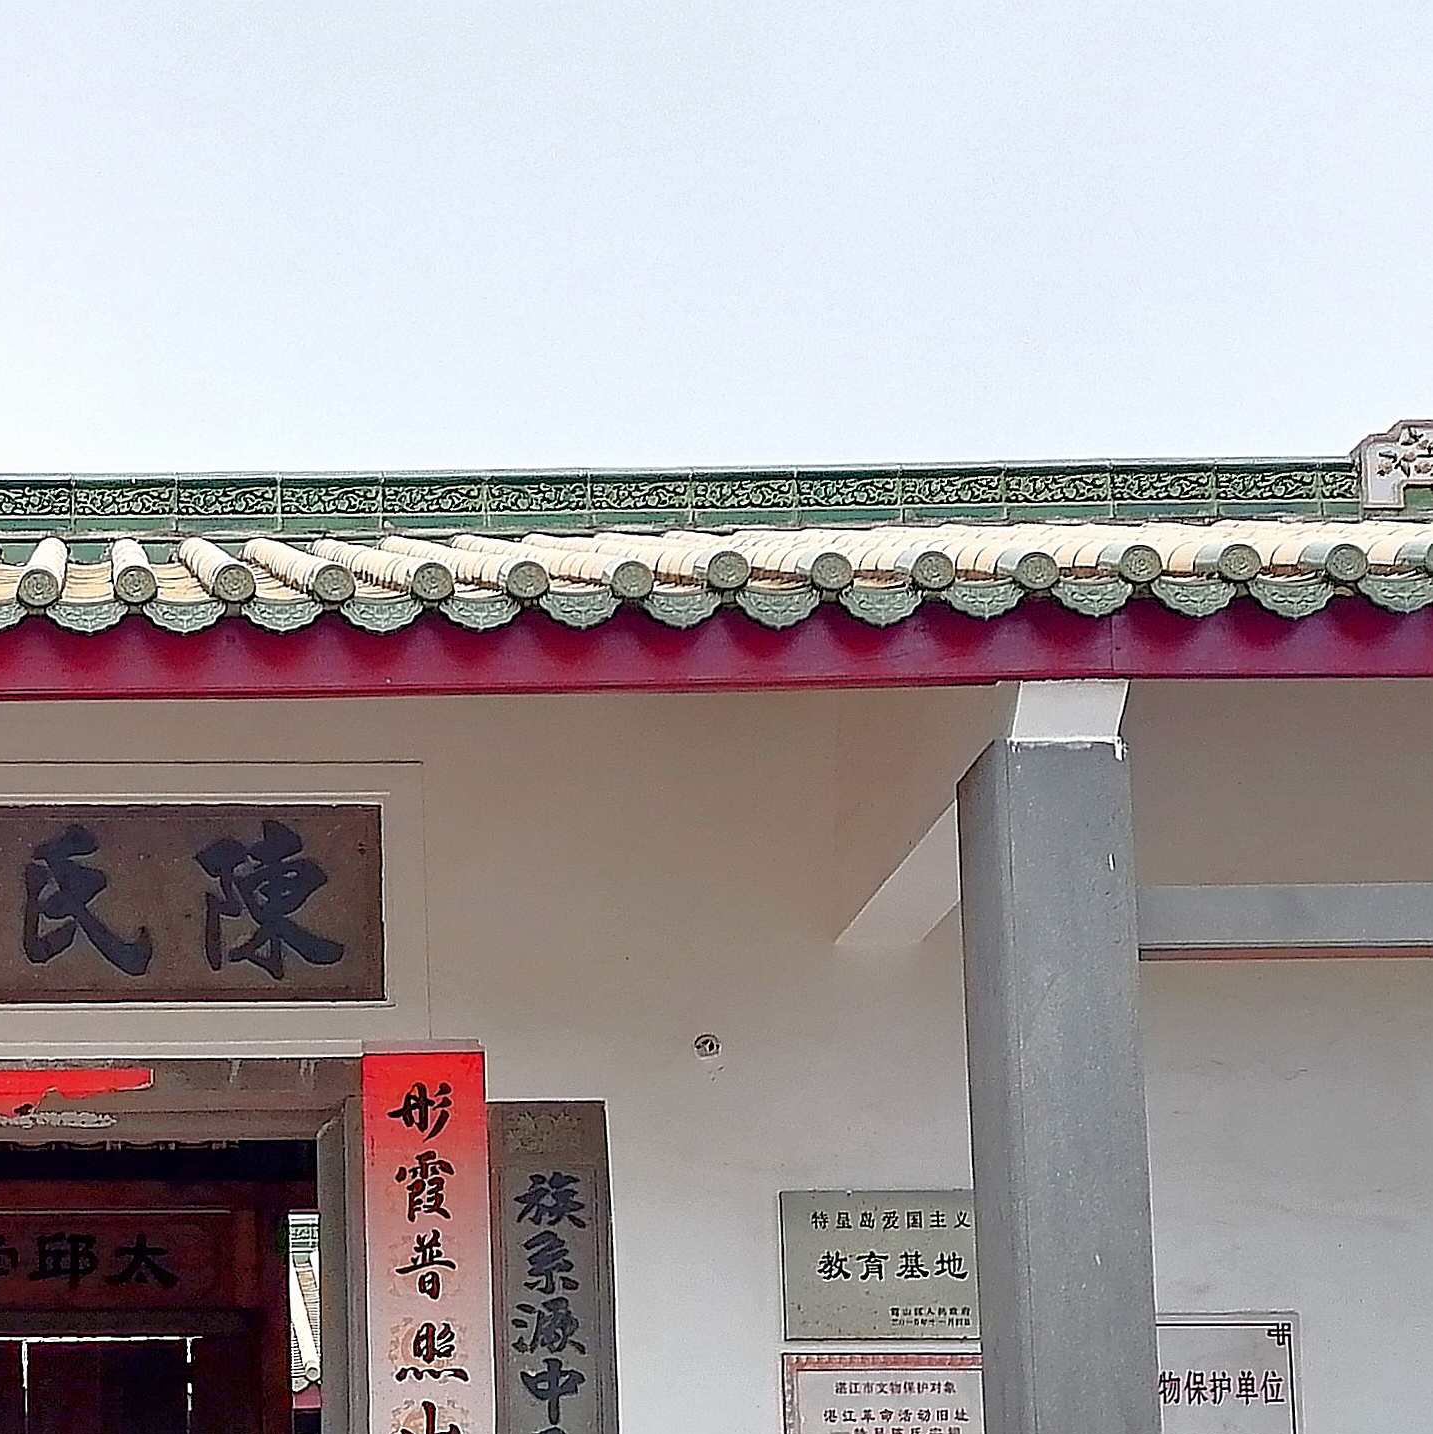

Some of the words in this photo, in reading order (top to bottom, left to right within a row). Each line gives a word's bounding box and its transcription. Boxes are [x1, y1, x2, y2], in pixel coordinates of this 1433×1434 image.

[811, 1210, 971, 1230] 特呈岛爱国主义
[817, 1250, 969, 1281] 教育基地
[834, 1381, 957, 1395] 湛江市文物保护对象
[823, 1408, 970, 1423] 湛江革命活动旧址
